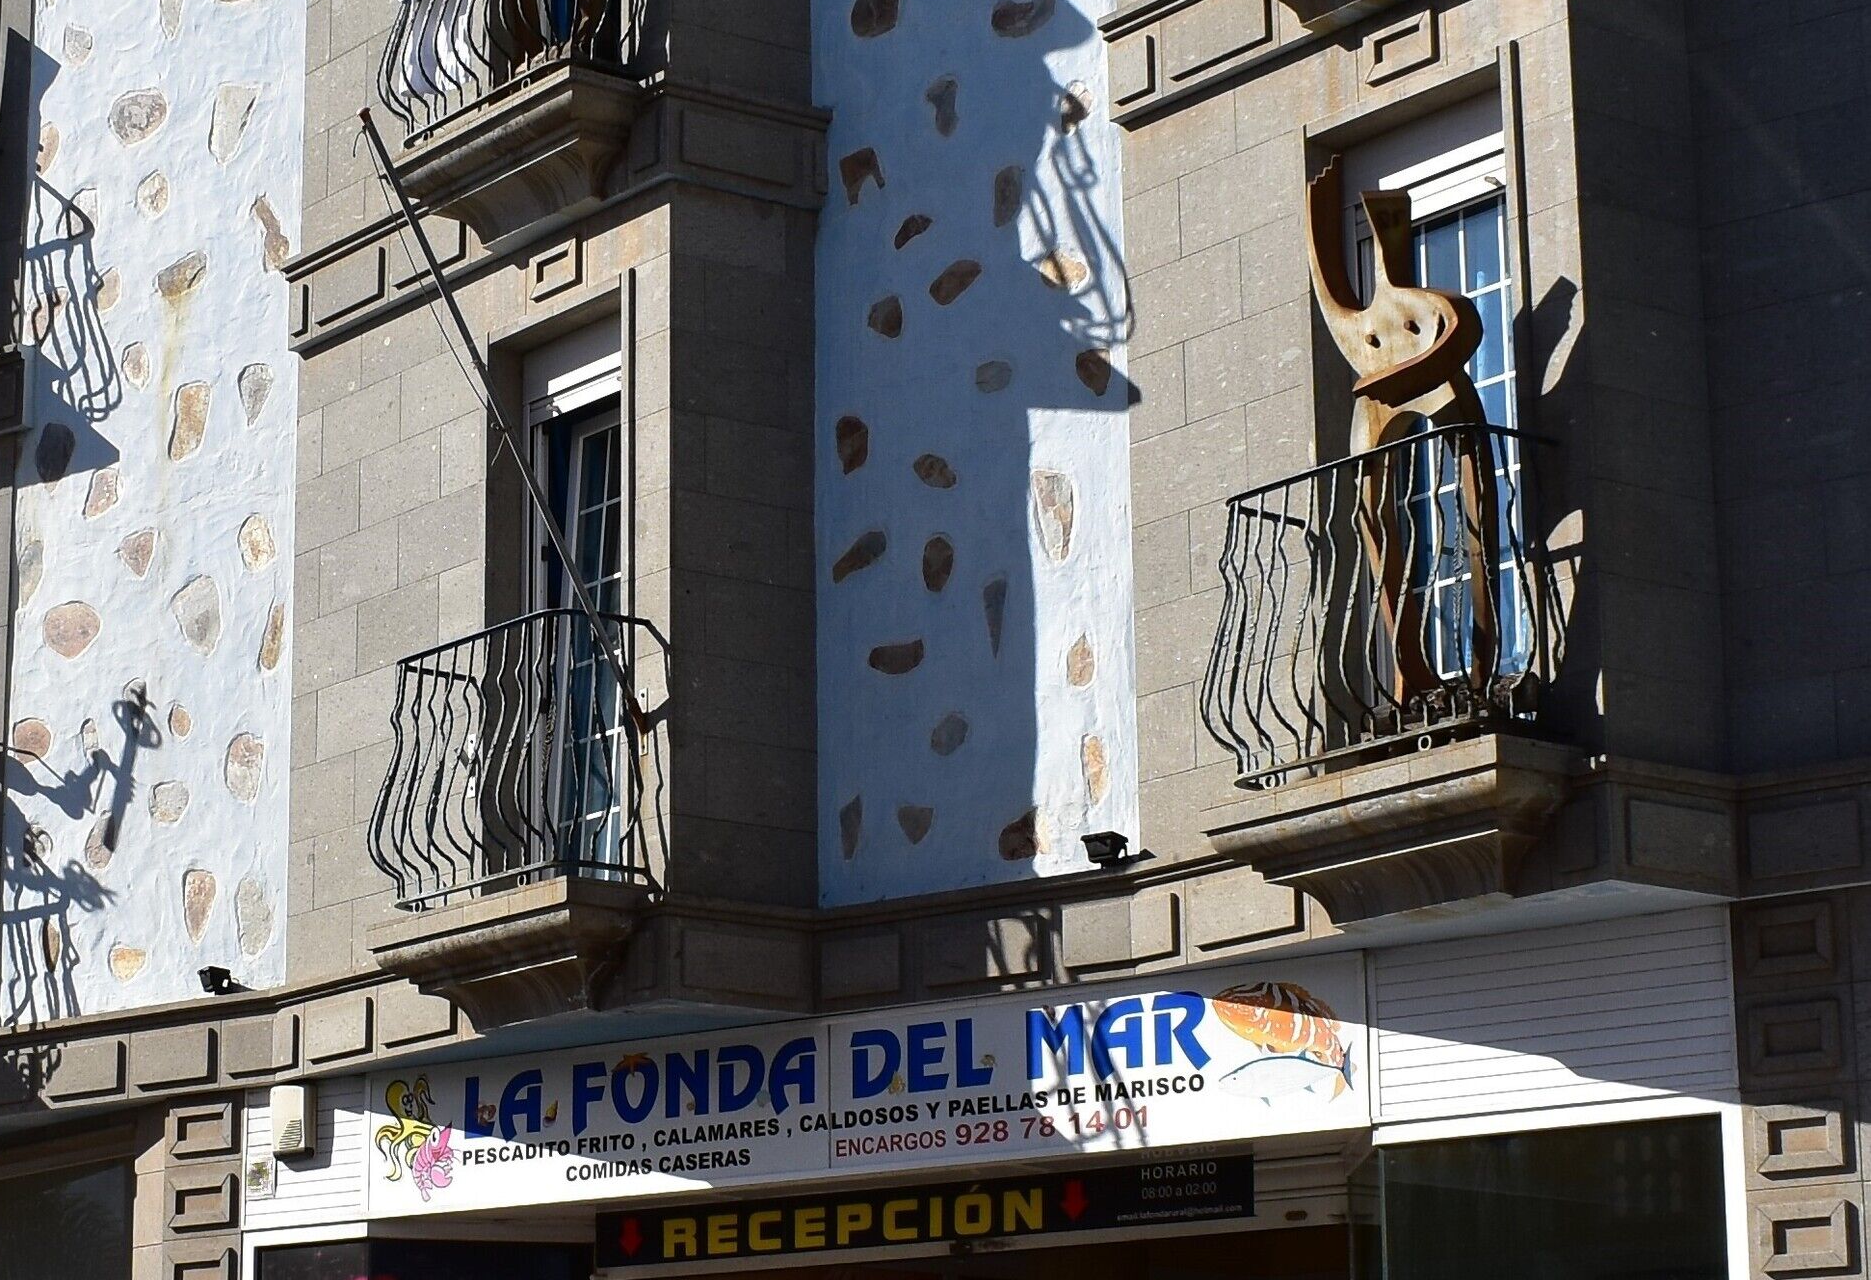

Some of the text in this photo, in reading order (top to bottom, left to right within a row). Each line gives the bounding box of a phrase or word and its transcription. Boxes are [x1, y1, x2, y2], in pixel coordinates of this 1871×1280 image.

[464, 991, 1212, 1143] LA FONDA DEL MAR
[462, 1141, 570, 1167] PESCADITO
[576, 1133, 636, 1156] FRITO
[653, 1119, 780, 1147] CALAMARES
[799, 1105, 919, 1133] CALDOSOS
[929, 1101, 941, 1120] Y
[948, 1090, 1049, 1117] PAELLAS
[1057, 1086, 1087, 1107] DE
[1095, 1073, 1206, 1102] MARISCO
[835, 1130, 947, 1158] ENCARGOS
[955, 1120, 1009, 1146] 928
[1021, 1116, 1056, 1140] 78
[566, 1148, 751, 1183] COMIDAS CASERAS
[1141, 1162, 1218, 1180] HORARIO
[662, 1185, 1044, 1259] RECEPCIÓN
